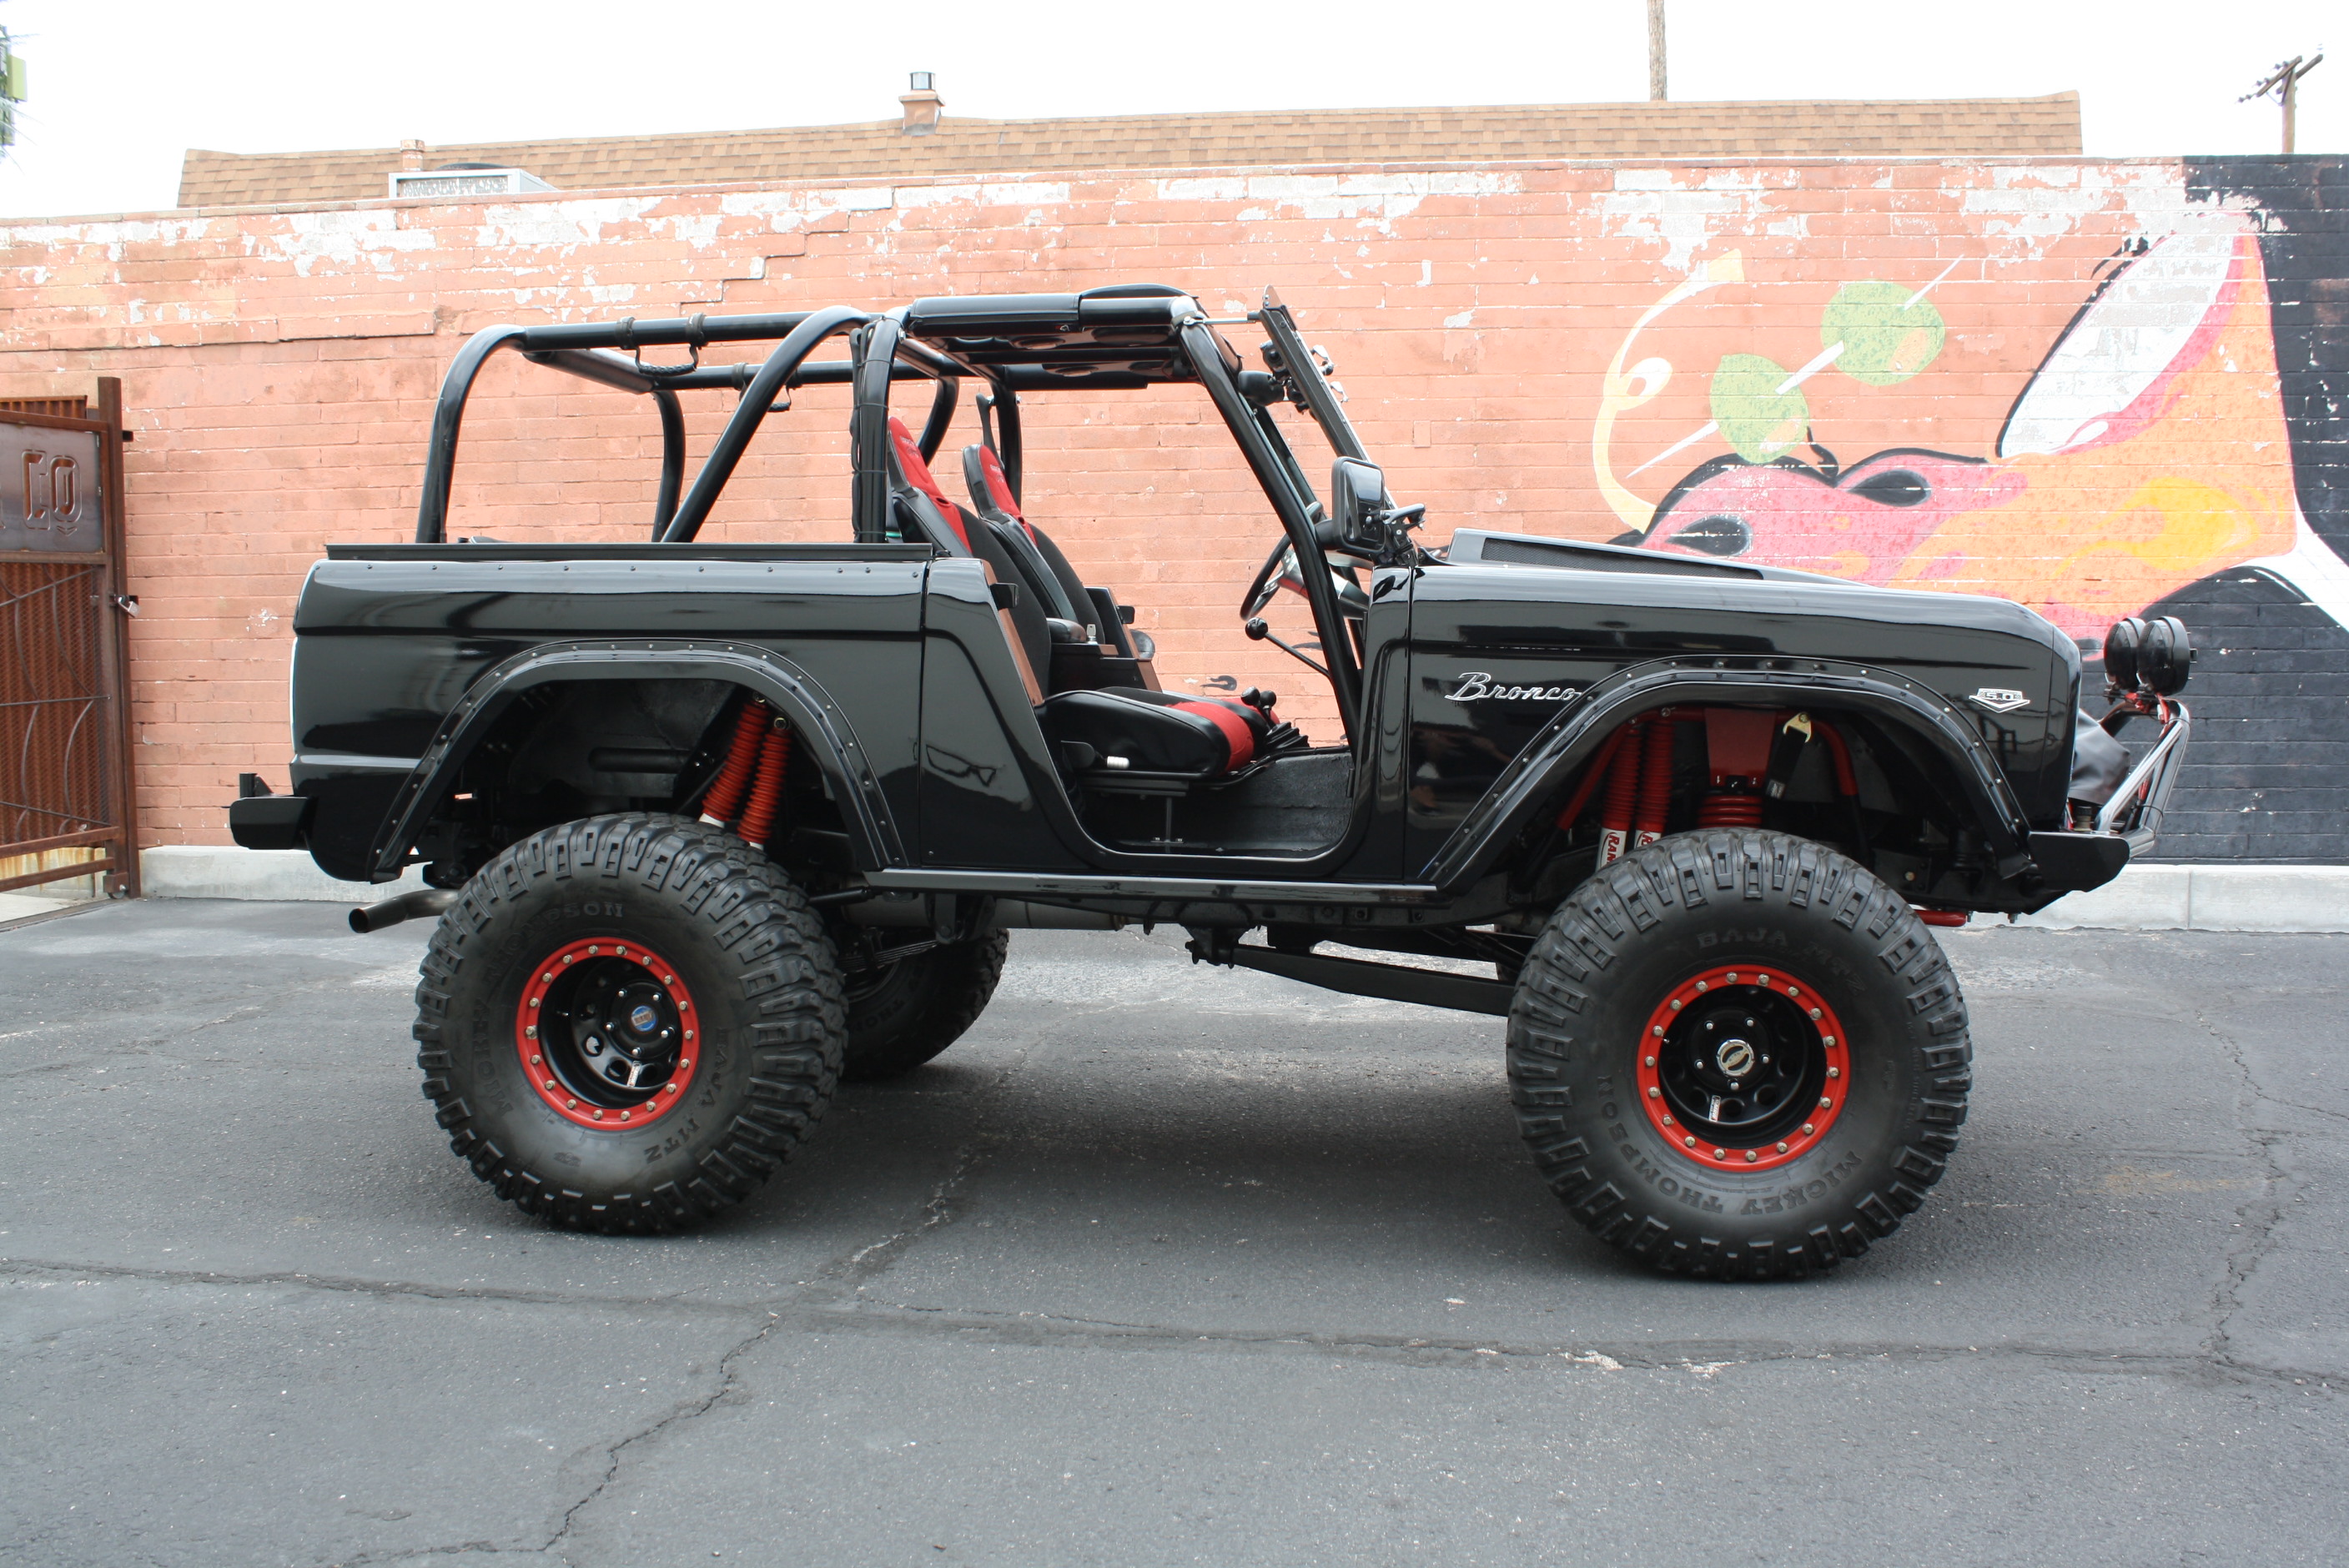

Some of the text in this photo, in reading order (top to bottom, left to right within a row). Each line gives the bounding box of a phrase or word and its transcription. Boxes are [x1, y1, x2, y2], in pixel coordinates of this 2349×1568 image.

[1444, 671, 1583, 701] Bronco
[1696, 927, 1789, 949] BAJA
[643, 1117, 702, 1164] MTZ
[1597, 1074, 1864, 1215] MICKEY THOMPSON
